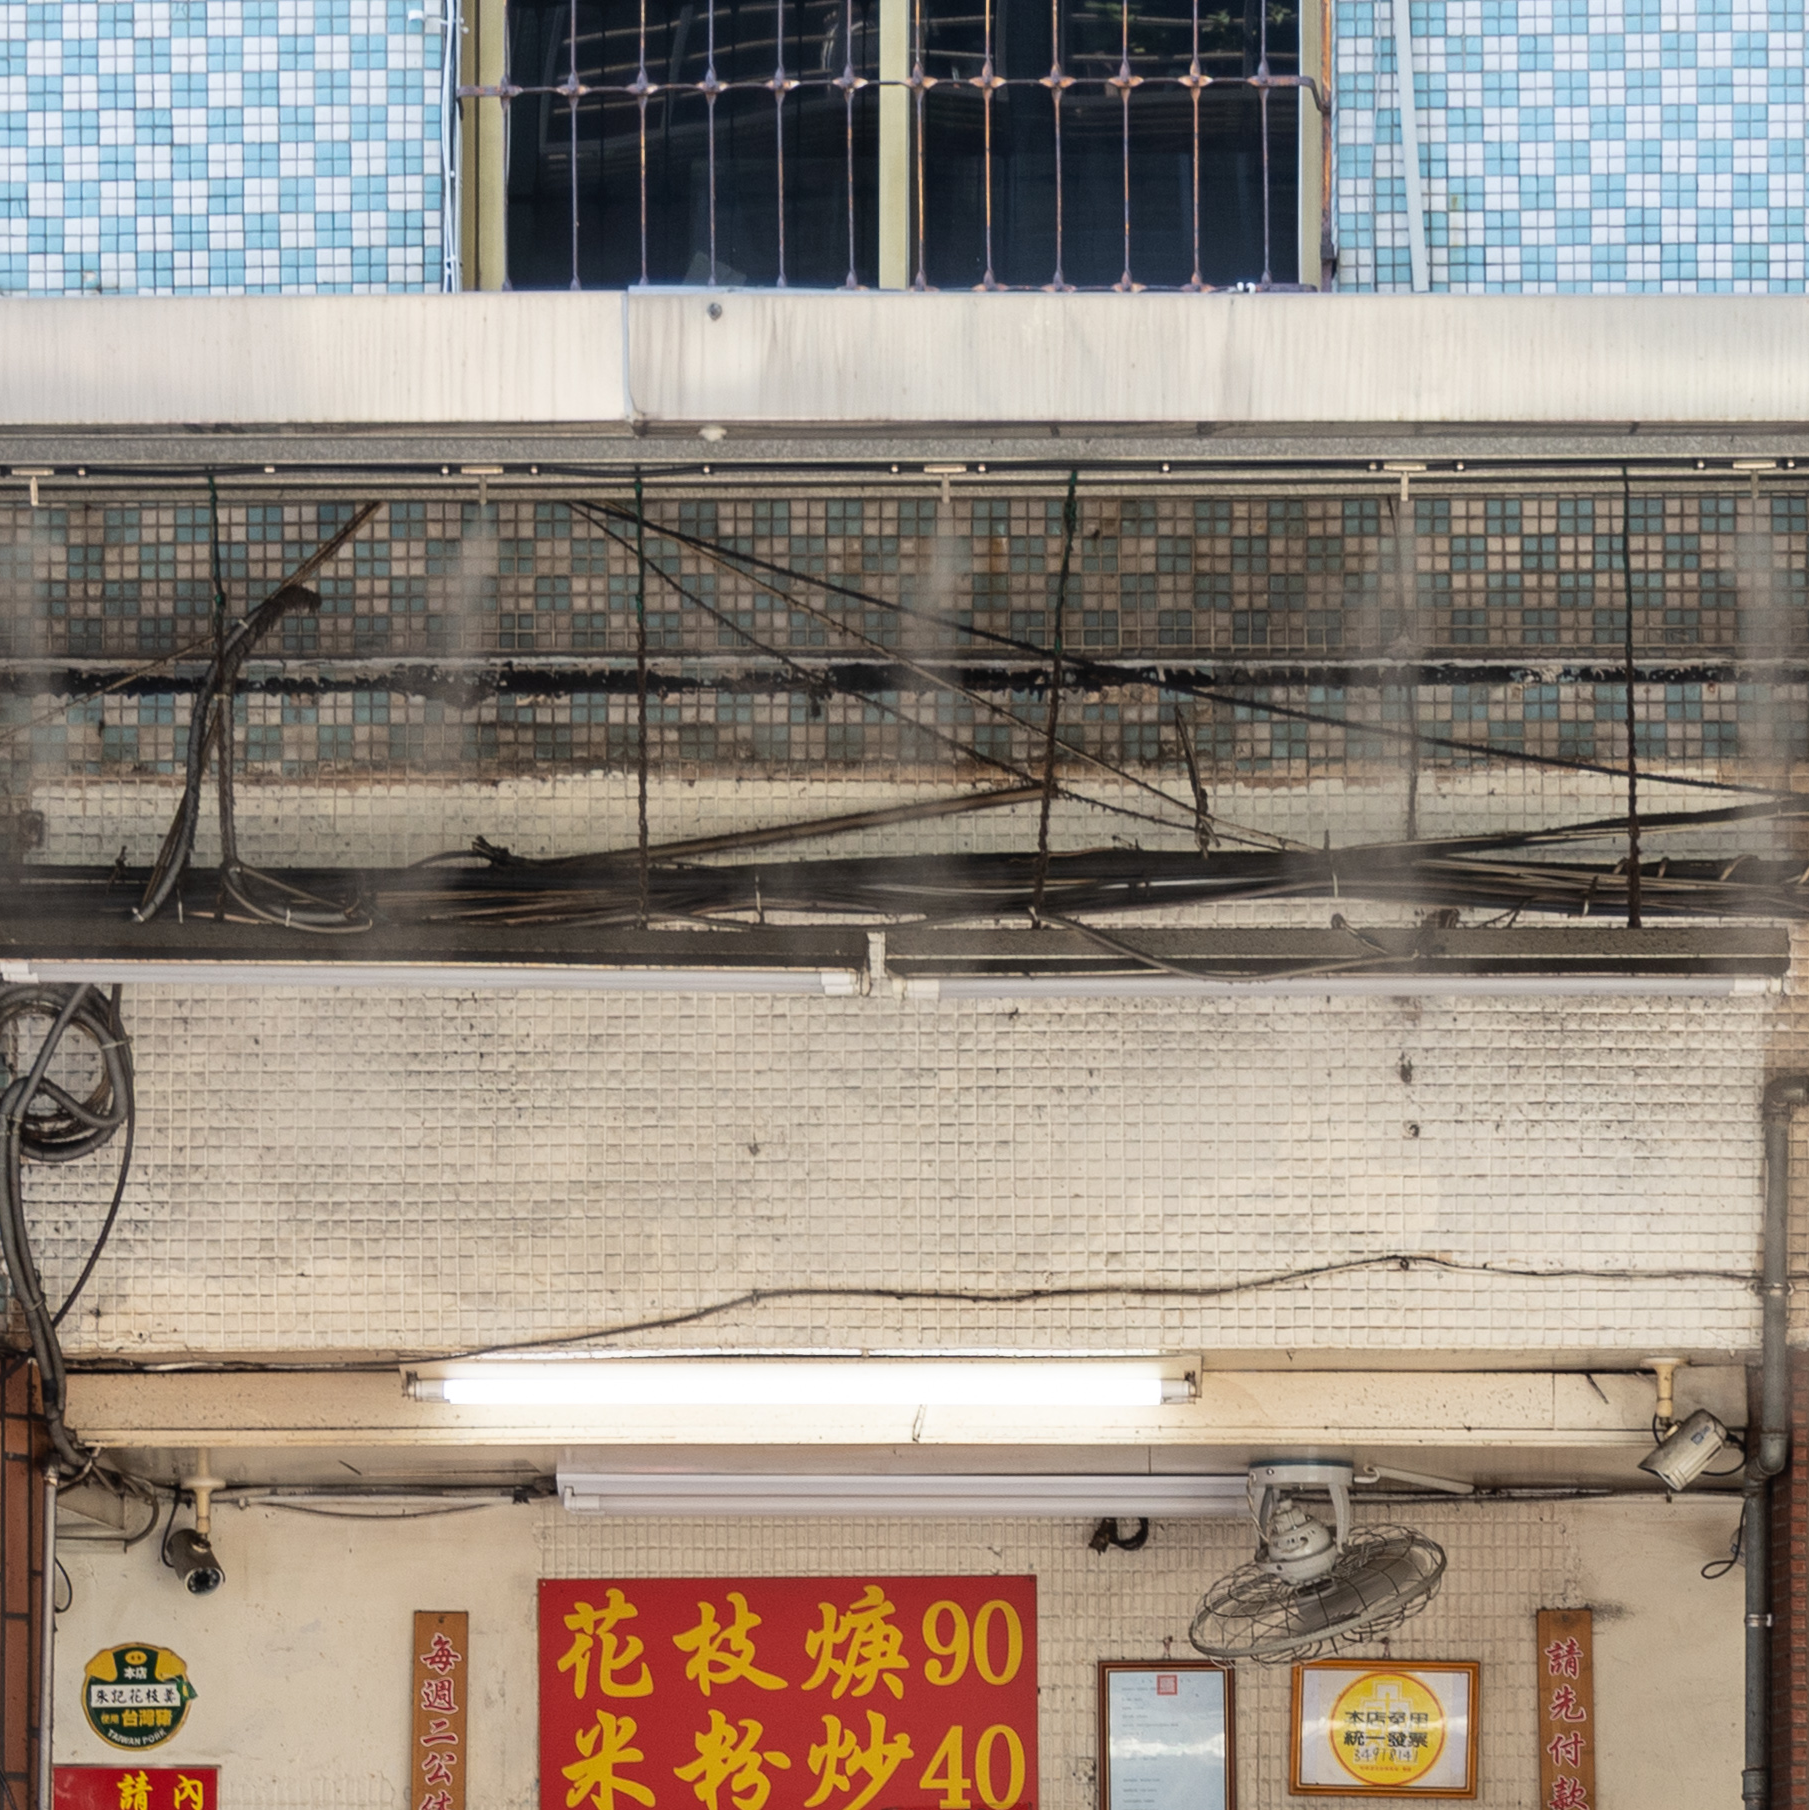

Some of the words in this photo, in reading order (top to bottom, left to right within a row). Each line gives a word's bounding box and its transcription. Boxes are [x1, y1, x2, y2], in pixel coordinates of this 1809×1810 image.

[124, 1666, 147, 1680] 本店
[108, 1729, 141, 1745] TAIWAN
[143, 1729, 167, 1745] PORK
[1344, 1731, 1428, 1748] 統一發票
